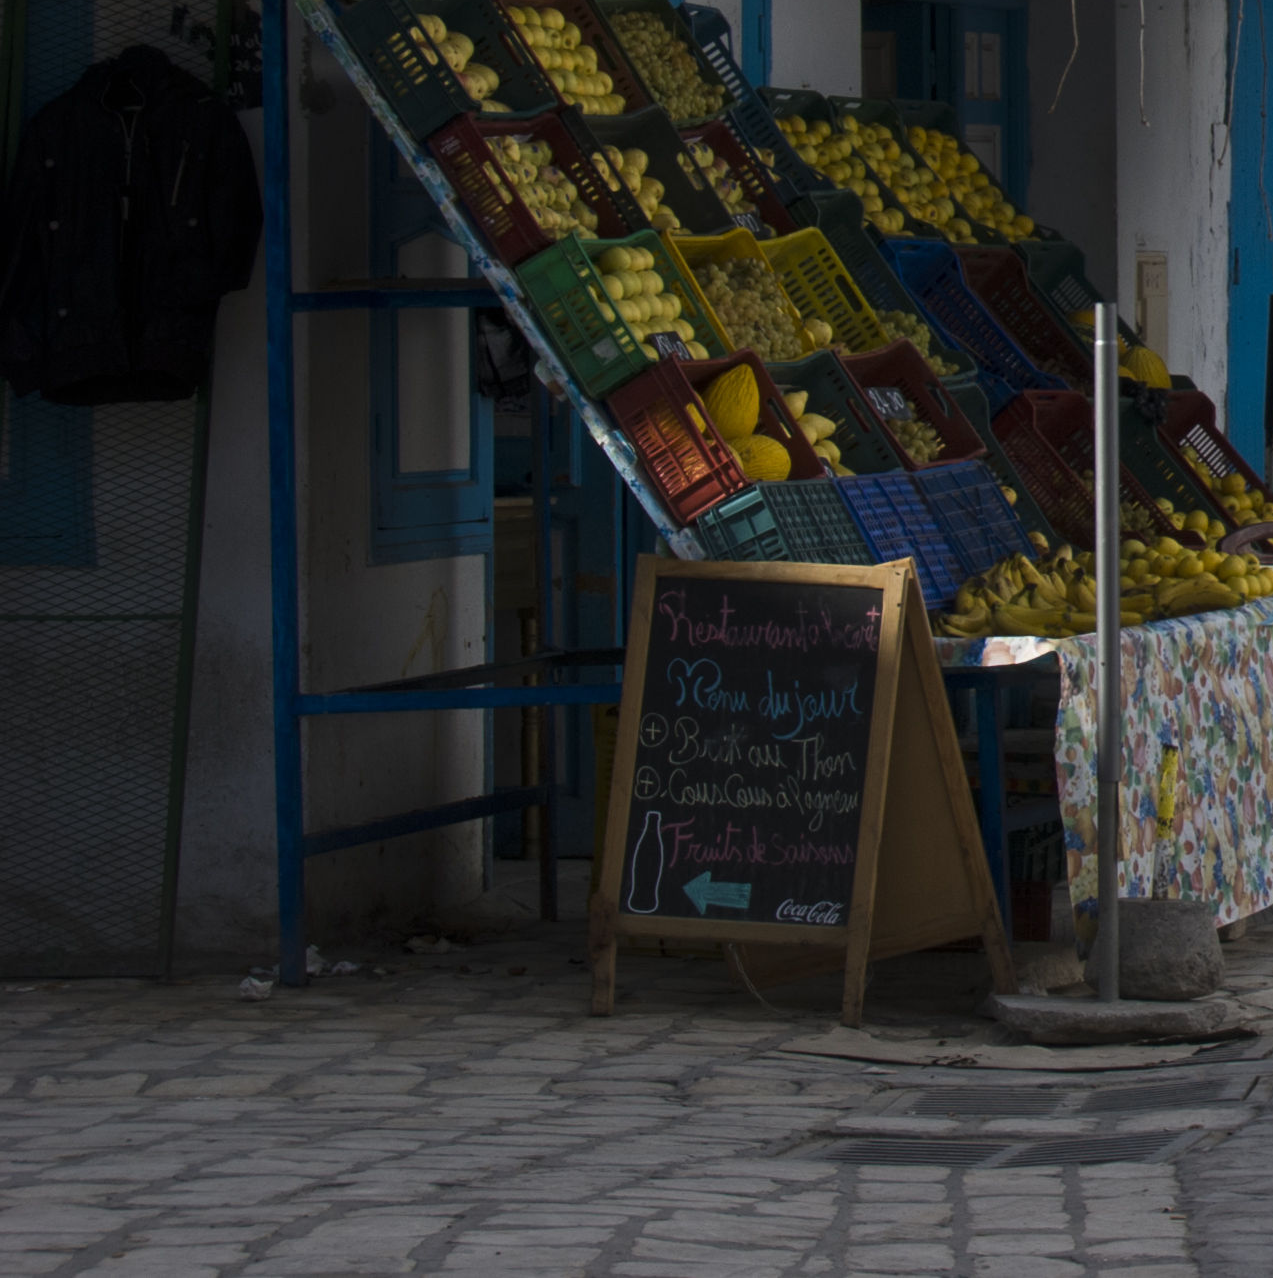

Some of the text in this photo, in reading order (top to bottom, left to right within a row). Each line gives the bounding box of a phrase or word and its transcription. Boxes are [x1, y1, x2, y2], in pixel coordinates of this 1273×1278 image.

[667, 657, 750, 712] Menu
[771, 680, 863, 740] jour
[748, 743, 788, 769] au
[791, 733, 857, 781] Thon
[660, 816, 742, 868] Fruits
[746, 826, 768, 864] de
[775, 897, 845, 925] Coca-Cola
